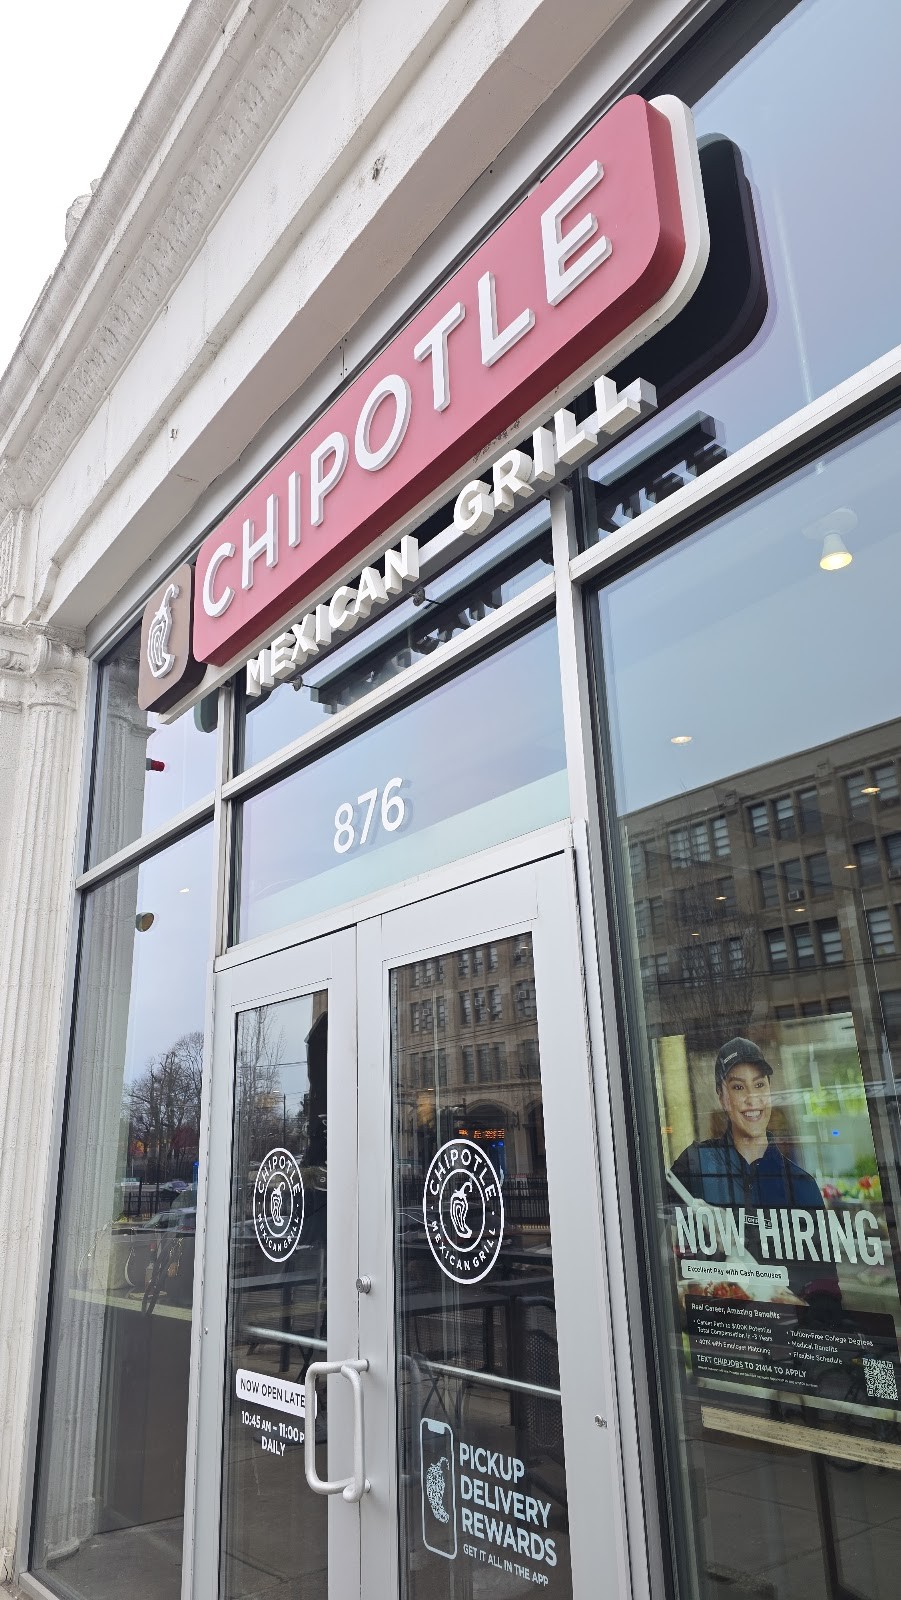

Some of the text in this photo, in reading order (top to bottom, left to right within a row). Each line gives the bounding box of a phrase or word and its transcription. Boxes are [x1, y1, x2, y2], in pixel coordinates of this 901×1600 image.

[202, 159, 613, 618] CHIPOTLE
[246, 374, 641, 697] MEXICAN GRILL
[333, 777, 405, 853] 876
[258, 1155, 300, 1196] CHIPOTLE
[430, 1149, 497, 1201] CHIPOTLE
[258, 1213, 300, 1251] MEXICAN GRILL
[432, 1220, 496, 1270] MEXICAN GRILL
[675, 1206, 885, 1266] NOW HIRING
[687, 1265, 782, 1279] Excellent Pay with Cash Bonuses
[691, 1303, 780, 1320] Real Career, Amazing Benefits
[790, 1330, 874, 1347] Tuition-Free College Degrees
[791, 1341, 838, 1353] Medical Benefits
[793, 1352, 843, 1364] Flexible Schedule
[696, 1354, 712, 1363] TEXT
[713, 1357, 743, 1369] CHIPJOBS
[744, 1361, 754, 1370] TO
[773, 1366, 783, 1374] TO
[785, 1368, 807, 1378] APPLY
[241, 1378, 306, 1408] NOW OPEN LATE
[241, 1411, 260, 1429] 10:45
[261, 1420, 272, 1433] AM
[279, 1422, 299, 1442] 11:00
[261, 1435, 286, 1456] DAILY
[459, 1442, 525, 1483] PICKUP
[460, 1475, 551, 1529] DELIVERY
[461, 1507, 557, 1567] REWARDS
[463, 1543, 549, 1587] GET IT ALL IN THE APP
